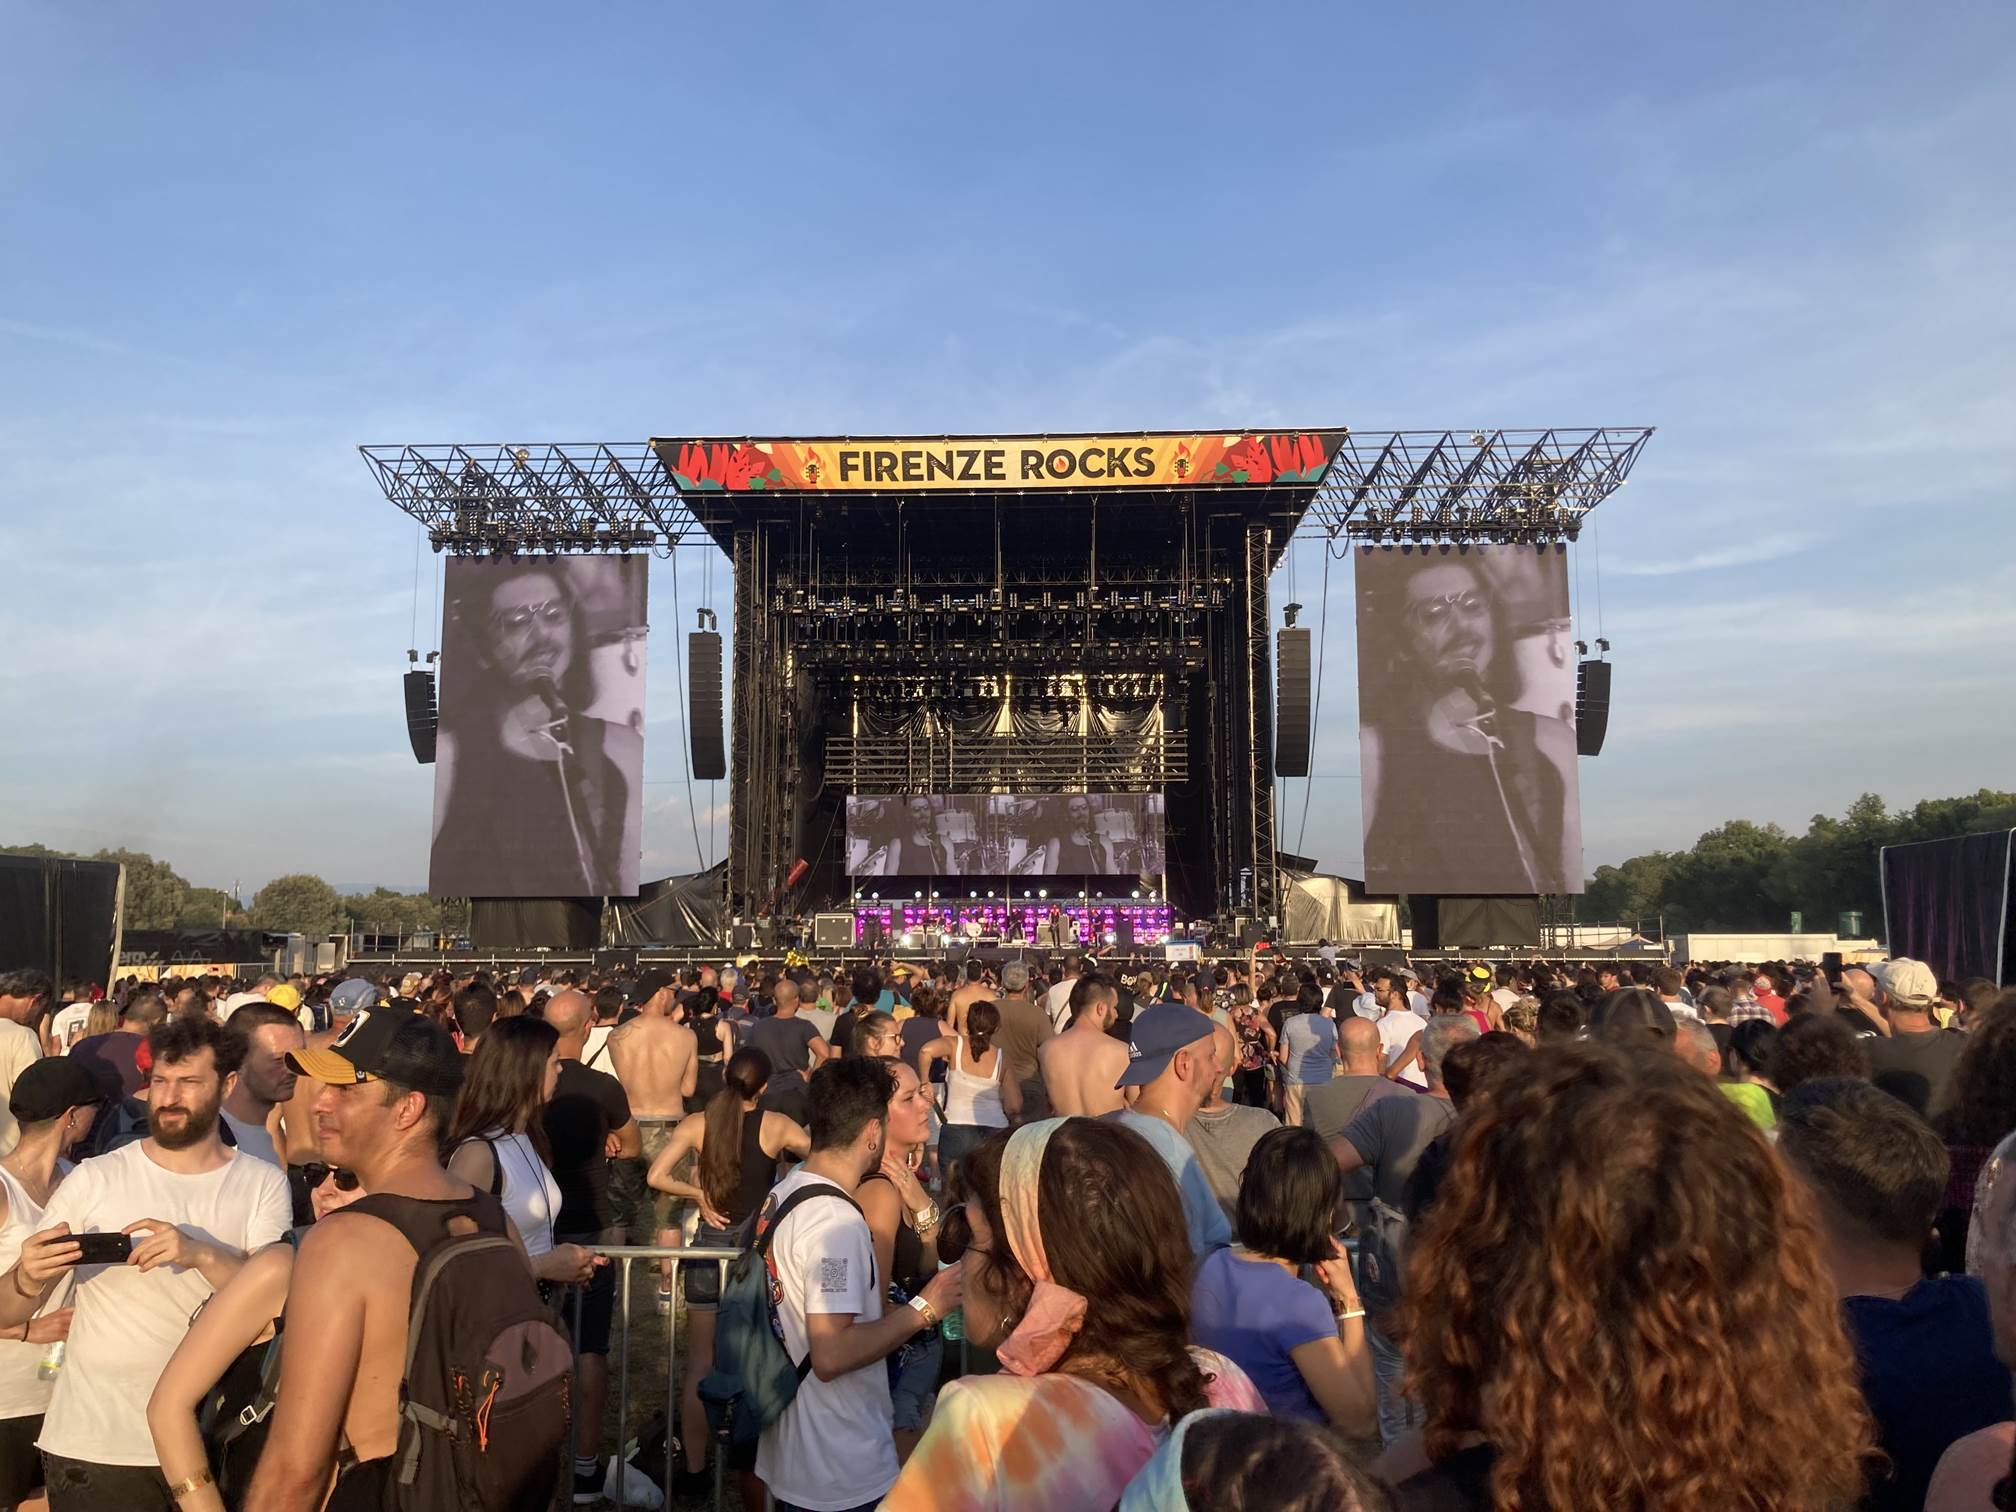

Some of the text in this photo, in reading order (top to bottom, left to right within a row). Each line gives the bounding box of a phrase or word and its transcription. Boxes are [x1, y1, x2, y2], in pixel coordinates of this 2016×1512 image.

[839, 447, 1156, 482] FIRENZE ROCKS
[118, 950, 161, 966] ergy
